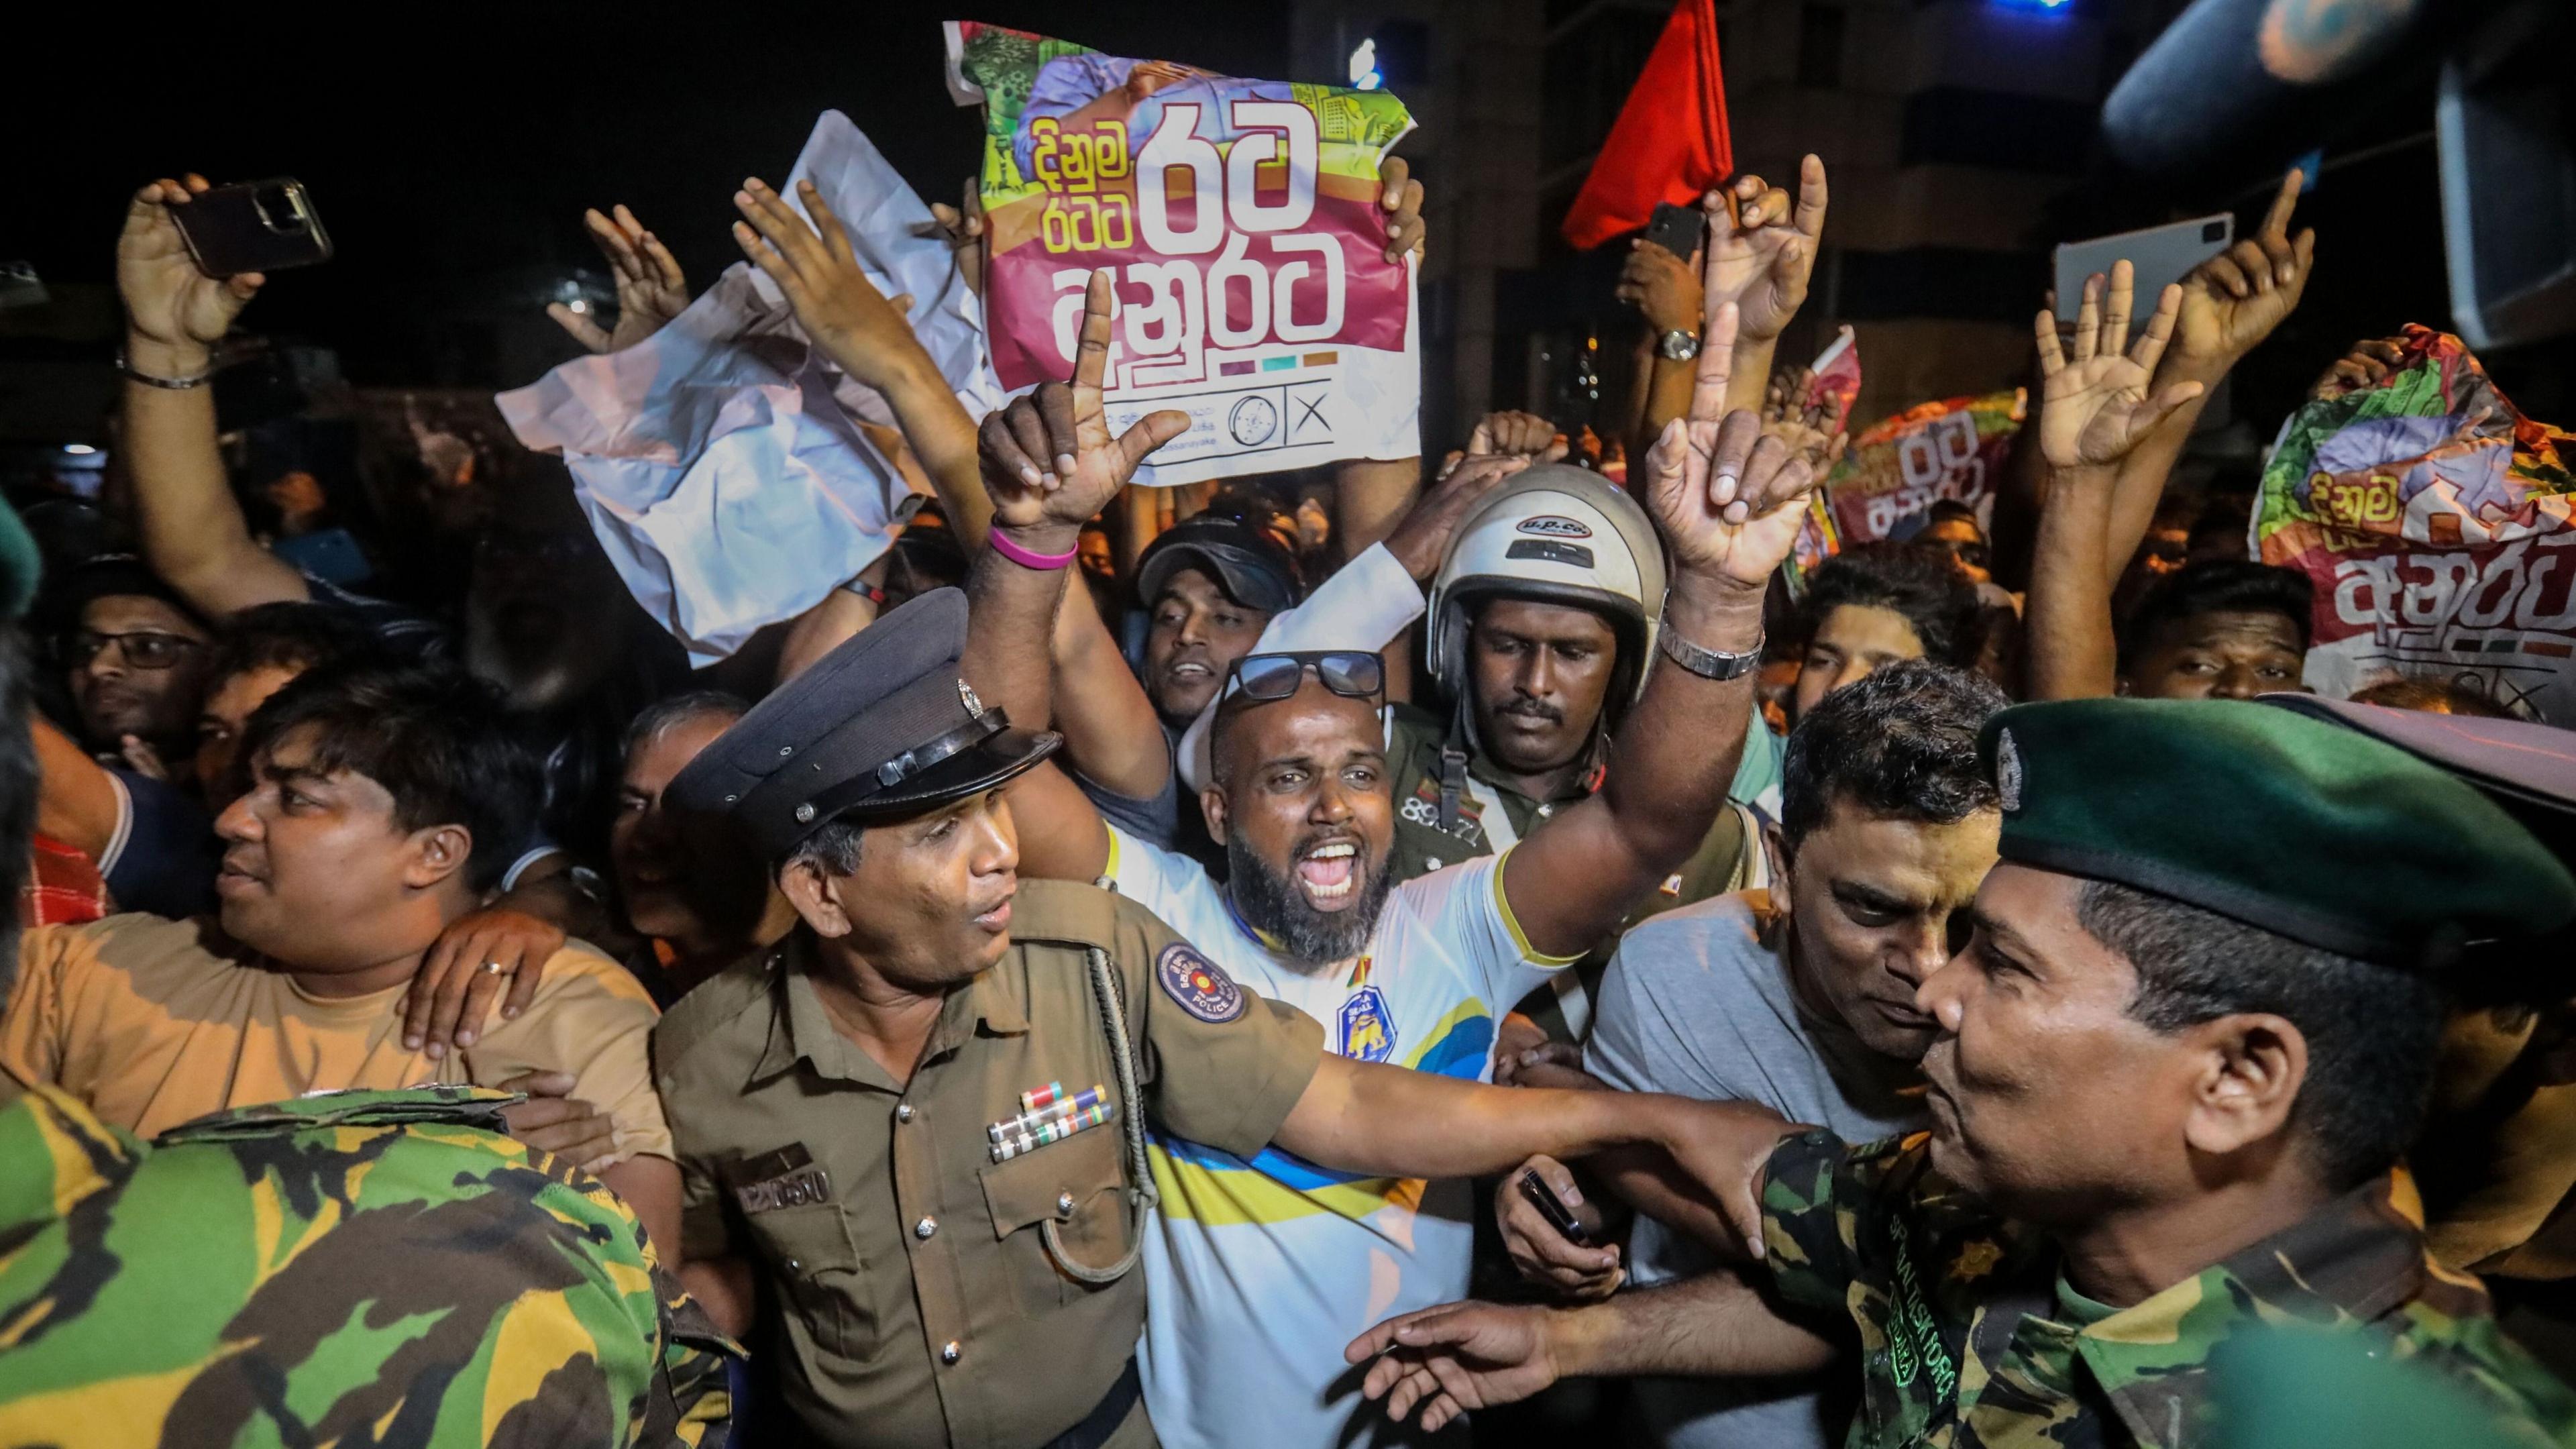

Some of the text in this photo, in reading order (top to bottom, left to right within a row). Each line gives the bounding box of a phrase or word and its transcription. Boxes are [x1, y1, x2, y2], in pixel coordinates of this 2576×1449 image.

[1031, 118, 1128, 193] දිනුම
[1138, 101, 1319, 255] රට
[1041, 193, 1134, 254] රටට
[1400, 797, 1483, 847] 8971
[1193, 994, 1229, 1013] POLICE
